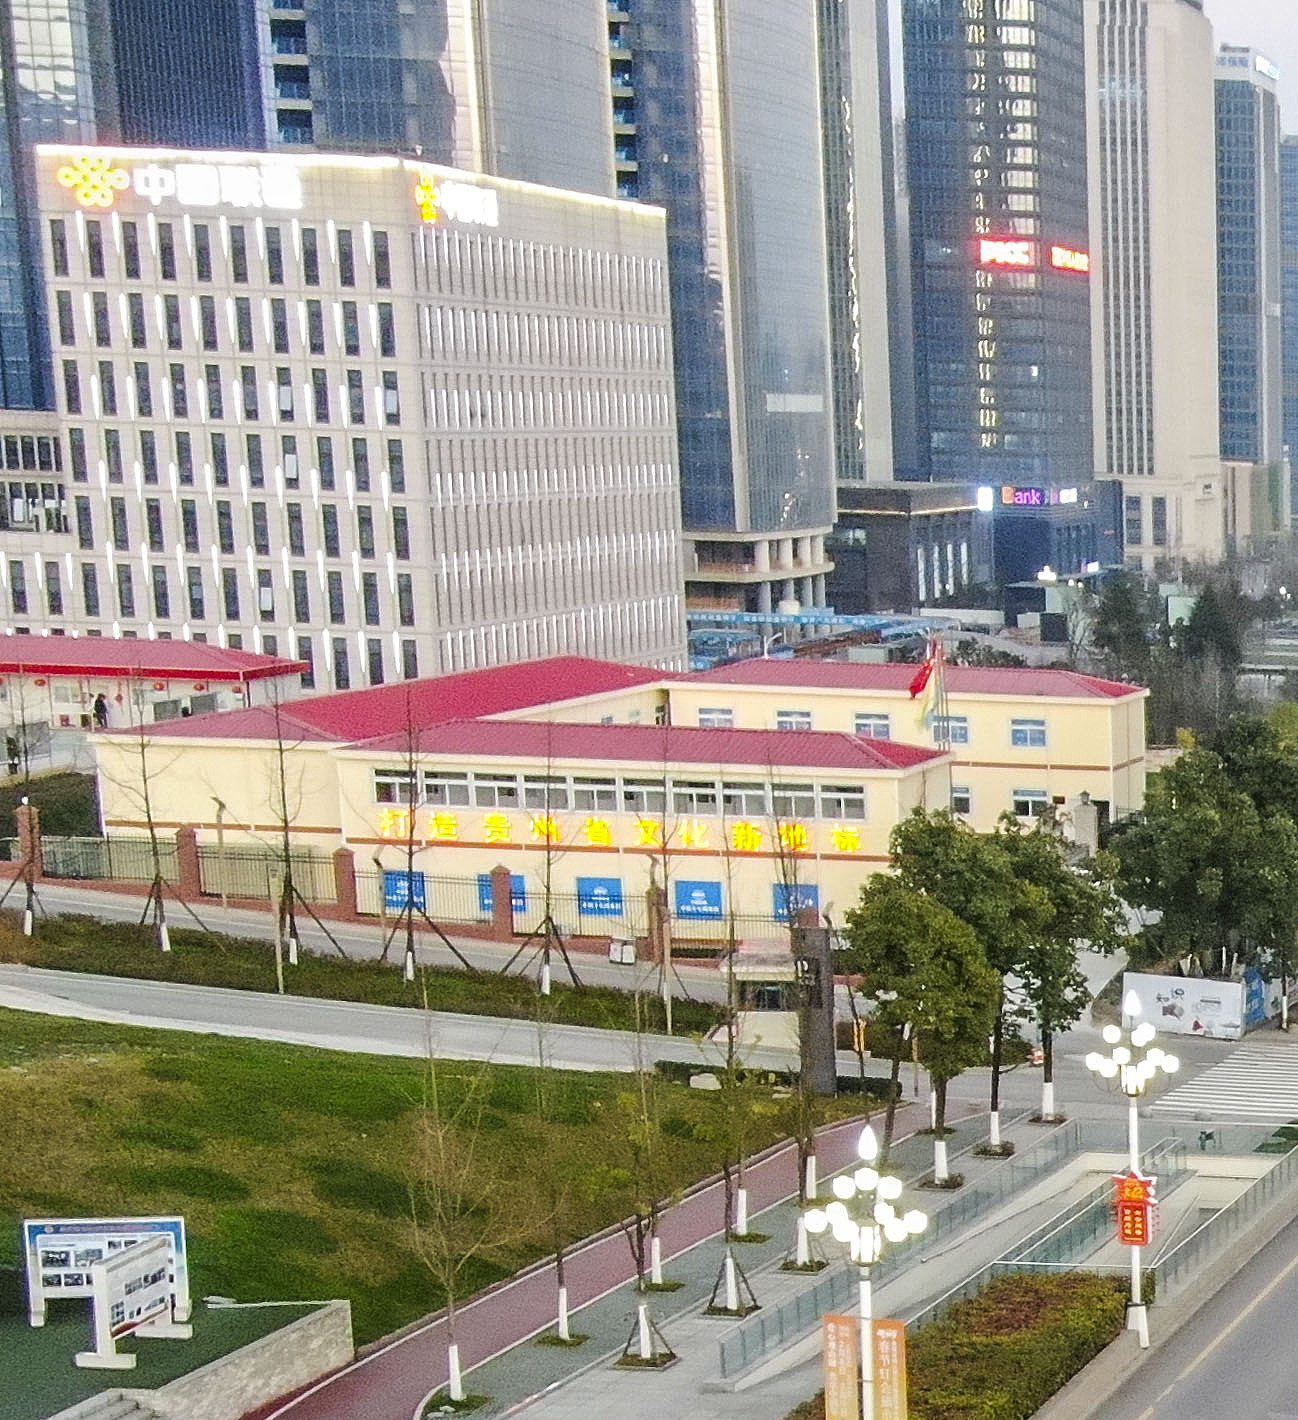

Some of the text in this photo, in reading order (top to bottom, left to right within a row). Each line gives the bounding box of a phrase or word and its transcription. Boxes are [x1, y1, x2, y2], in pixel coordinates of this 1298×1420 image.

[1002, 486, 1042, 505] Bank
[380, 807, 864, 852] 打造贵州省文化新地标
